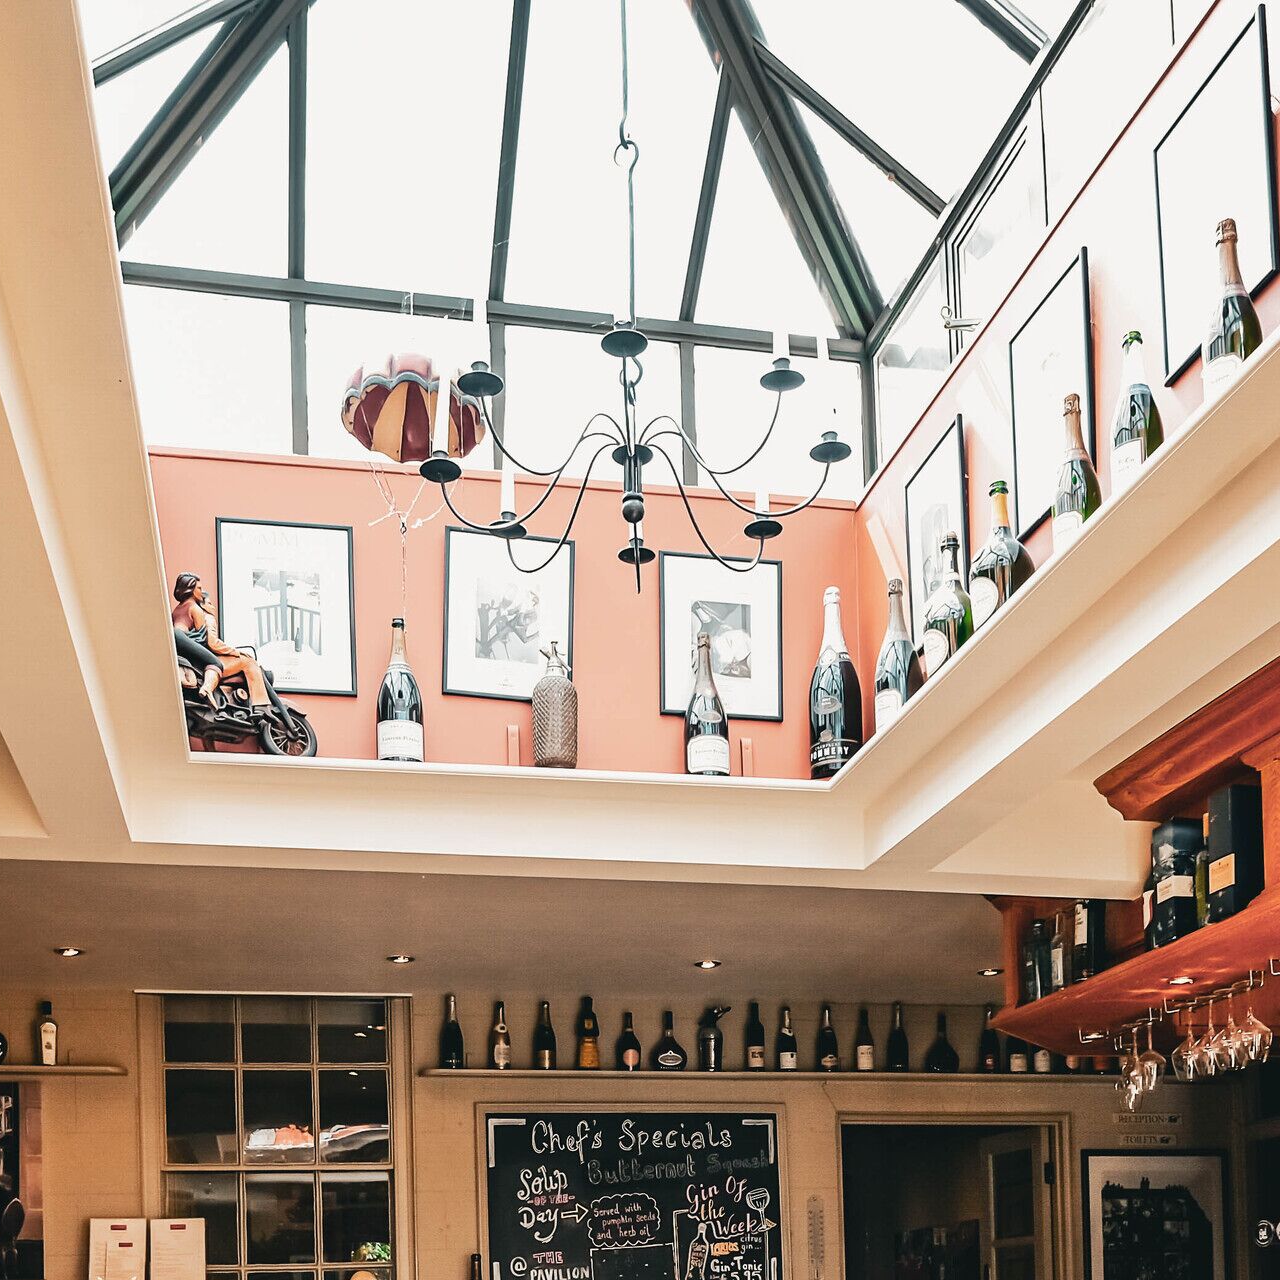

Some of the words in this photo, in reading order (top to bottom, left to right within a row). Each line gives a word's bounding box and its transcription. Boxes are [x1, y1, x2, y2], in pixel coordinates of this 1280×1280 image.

[810, 746, 849, 762] POMMERY
[1118, 1115, 1165, 1123] RECEPTION
[531, 1119, 602, 1165] Chef's
[619, 1119, 734, 1155] Specials
[1124, 1135, 1158, 1144] TOILETS
[587, 1154, 696, 1185] Butternut
[517, 1165, 568, 1201] Soup
[686, 1184, 719, 1214] Gin
[594, 1203, 620, 1217] Served
[624, 1202, 641, 1213] with
[700, 1199, 726, 1221] the
[518, 1207, 559, 1244] Day
[602, 1215, 632, 1230] pumpkin
[716, 1213, 761, 1236] Week
[596, 1229, 613, 1240] and
[620, 1225, 637, 1237] herb
[639, 1223, 651, 1237] oil
[740, 1233, 762, 1243] citrus
[532, 1251, 564, 1264] THE
